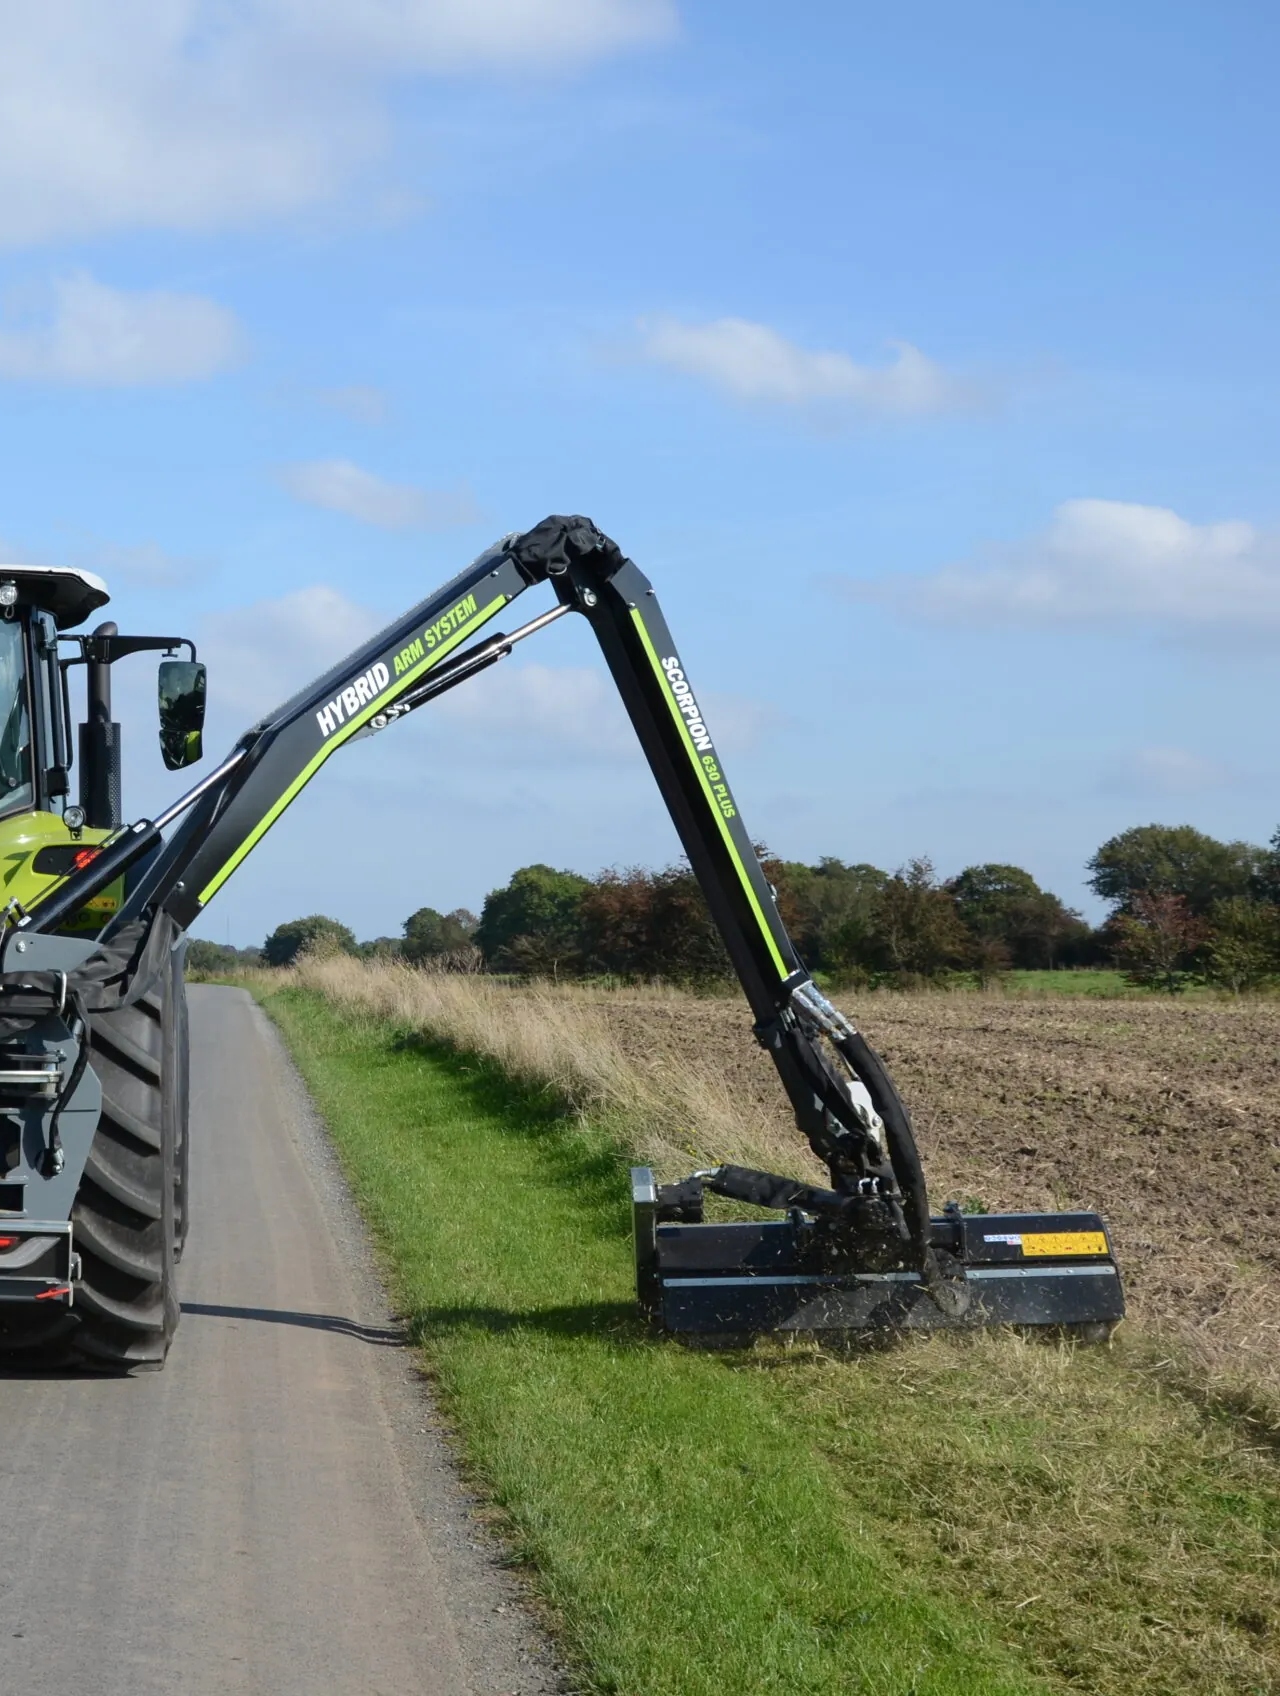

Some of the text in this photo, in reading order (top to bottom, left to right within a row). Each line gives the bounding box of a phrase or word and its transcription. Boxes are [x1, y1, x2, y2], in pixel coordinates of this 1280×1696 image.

[316, 593, 478, 737] HYBRID ARM SYSTEM
[661, 656, 736, 818] SCORPION 630 PLUS
